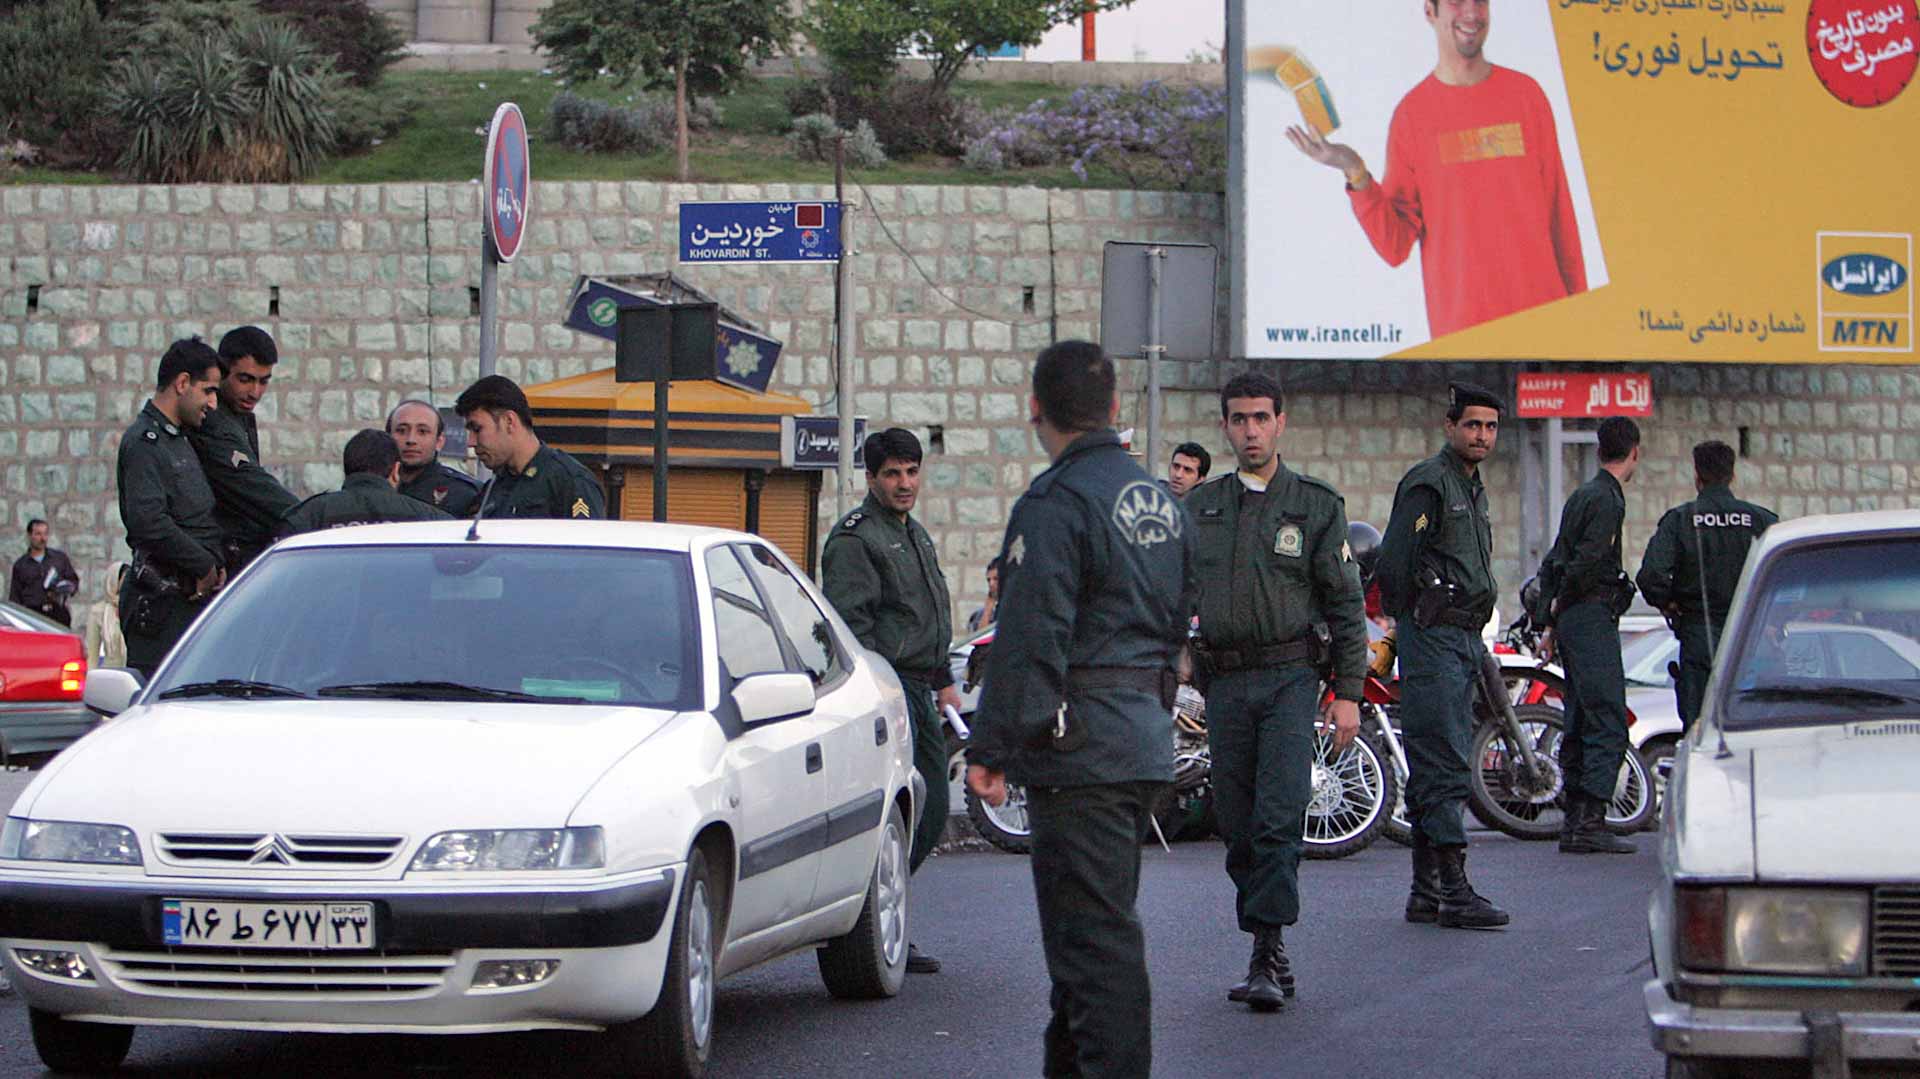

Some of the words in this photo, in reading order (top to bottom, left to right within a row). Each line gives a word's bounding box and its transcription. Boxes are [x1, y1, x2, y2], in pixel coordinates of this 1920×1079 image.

[1816, 9, 1867, 60] تاریخ
[1687, 36, 1784, 81] تحویل
[1841, 36, 1913, 77] مصرف
[767, 204, 793, 214] خیابان
[690, 216, 784, 247] خوردین
[689, 248, 750, 259] KHOVARDIN
[755, 248, 771, 259] ST.
[1832, 259, 1898, 293] ایرانسل
[1266, 323, 1403, 342] www.irancell.ir
[1748, 311, 1805, 342] شماره
[1833, 320, 1898, 343] MTN
[1119, 489, 1175, 529] NAJA
[1693, 513, 1752, 527] POLICE
[331, 916, 368, 944] ۳۳
